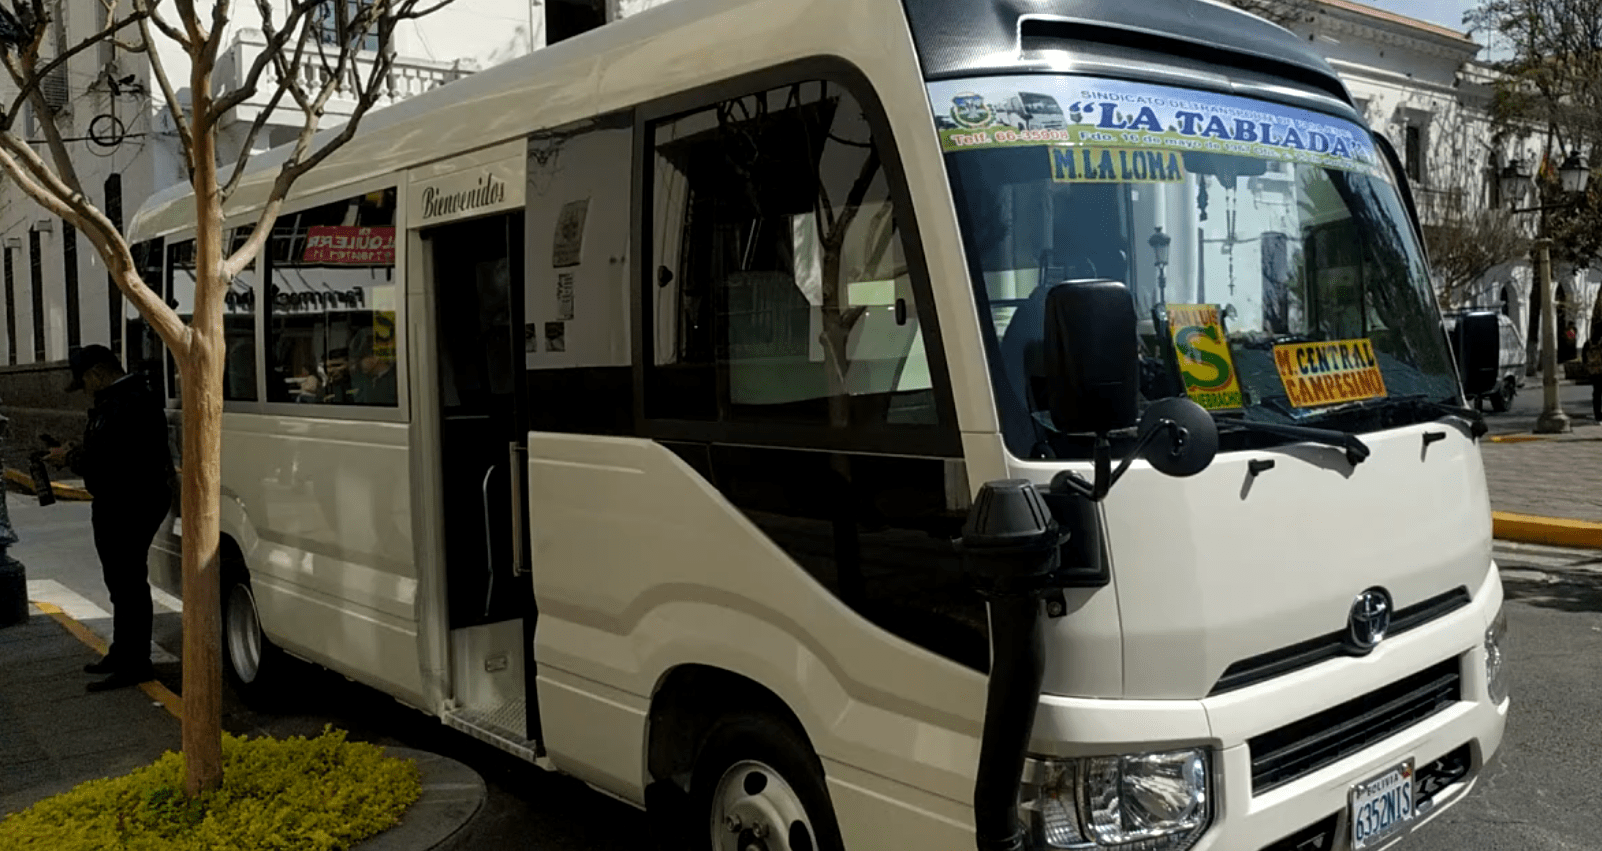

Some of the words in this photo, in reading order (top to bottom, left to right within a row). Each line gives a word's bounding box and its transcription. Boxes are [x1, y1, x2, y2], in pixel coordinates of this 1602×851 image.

[1081, 90, 1165, 106] SINDICATO
[952, 132, 991, 145] Telf.
[1164, 138, 1202, 150] mayo
[422, 172, 505, 219] Bienvenidos
[1174, 325, 1230, 390] S
[1285, 370, 1385, 404] CAMPESINO
[1356, 781, 1410, 841] 6352NIS
